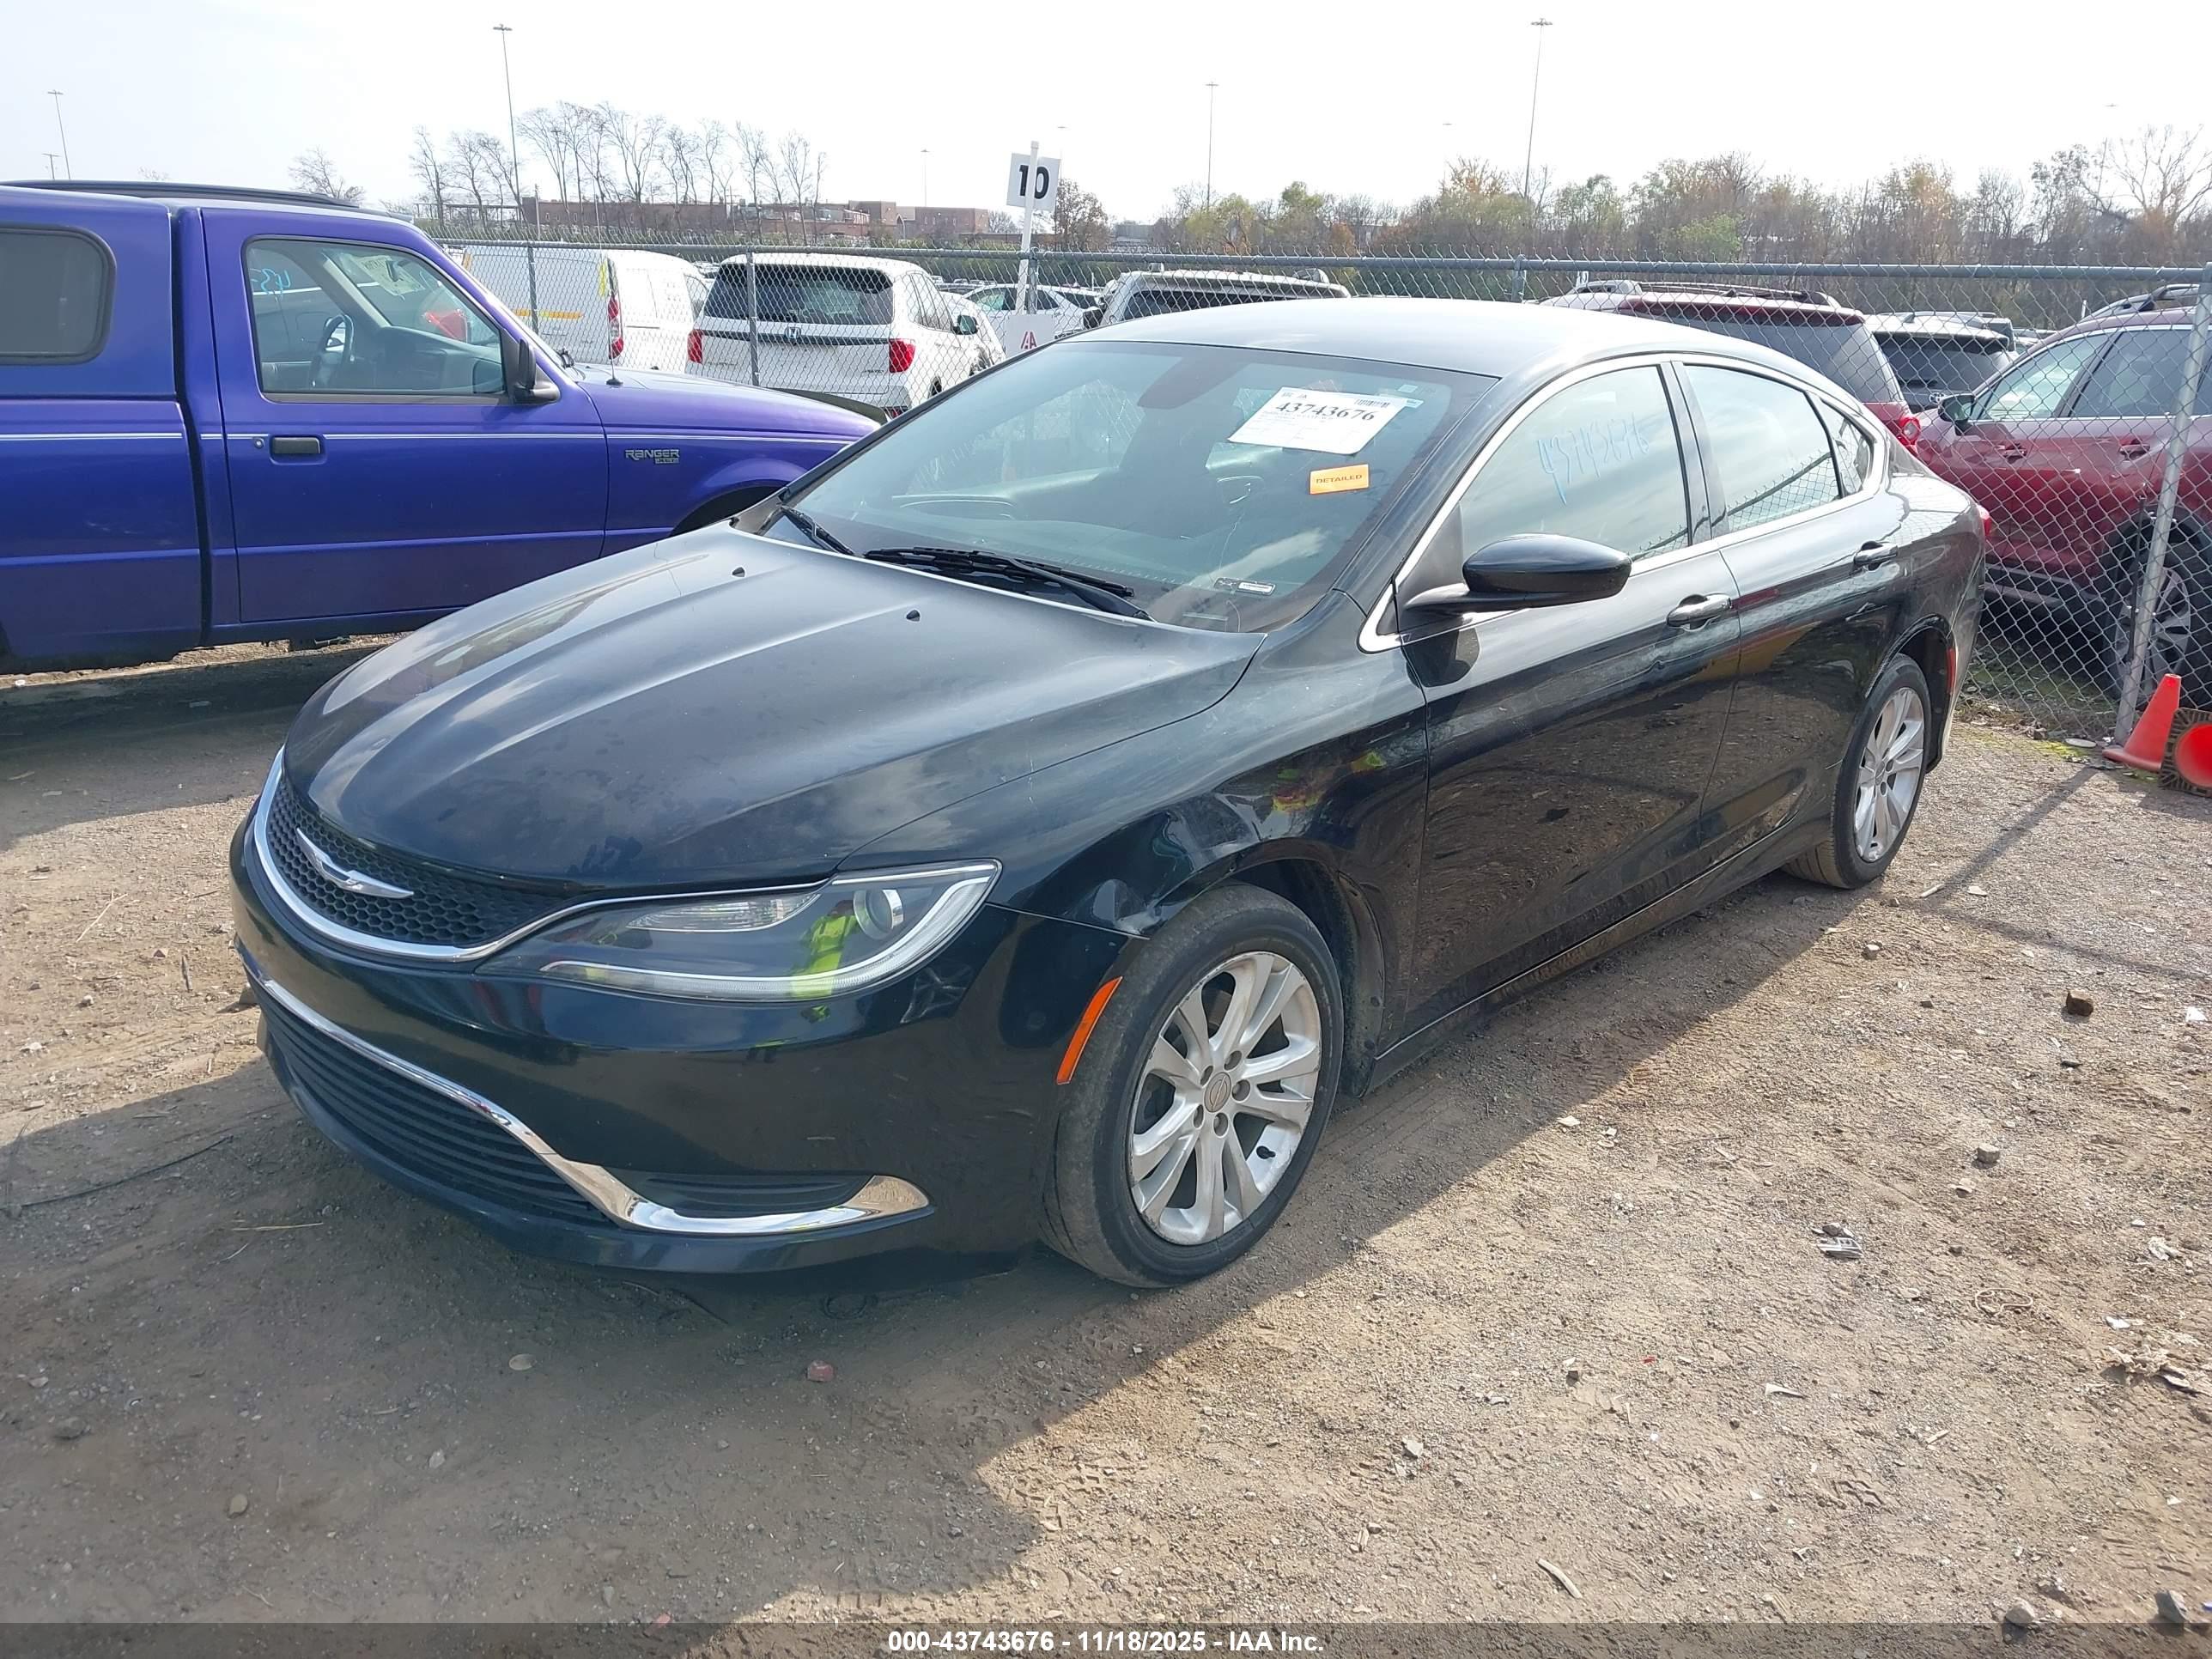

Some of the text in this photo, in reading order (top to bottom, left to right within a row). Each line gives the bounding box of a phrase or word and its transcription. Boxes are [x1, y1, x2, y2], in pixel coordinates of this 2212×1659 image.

[1275, 402, 1379, 421] 43743676
[624, 449, 680, 461] RANGER
[1316, 474, 1363, 483] DETAILED
